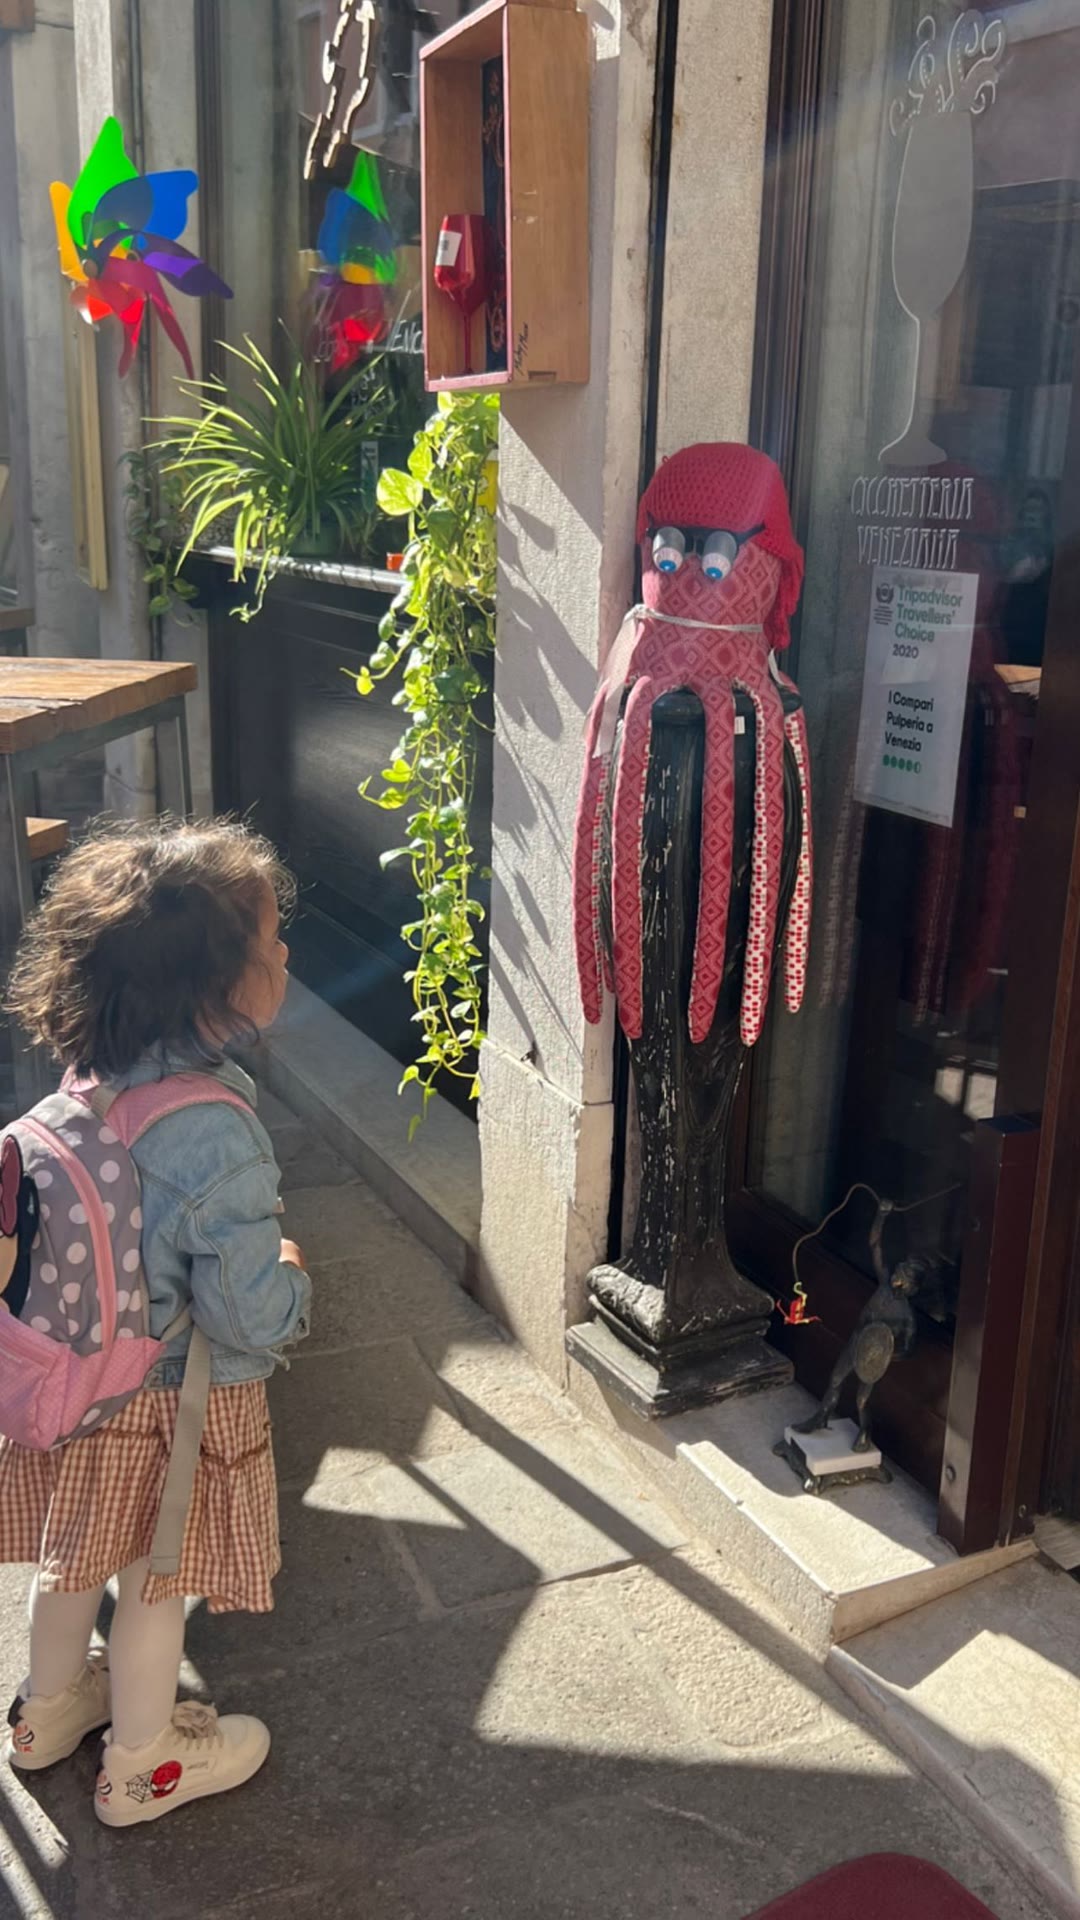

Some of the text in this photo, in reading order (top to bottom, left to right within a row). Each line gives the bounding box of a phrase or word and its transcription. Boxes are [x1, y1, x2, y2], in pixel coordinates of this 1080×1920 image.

[857, 525, 960, 569] VENEZIANA
[898, 584, 963, 607] Tripadvisor
[896, 603, 955, 625] Travellers'
[894, 622, 935, 642] Choice
[892, 643, 920, 659] 2020
[893, 691, 934, 712] Compari
[885, 711, 934, 733] Pulperia a
[884, 731, 922, 751] Venezia
